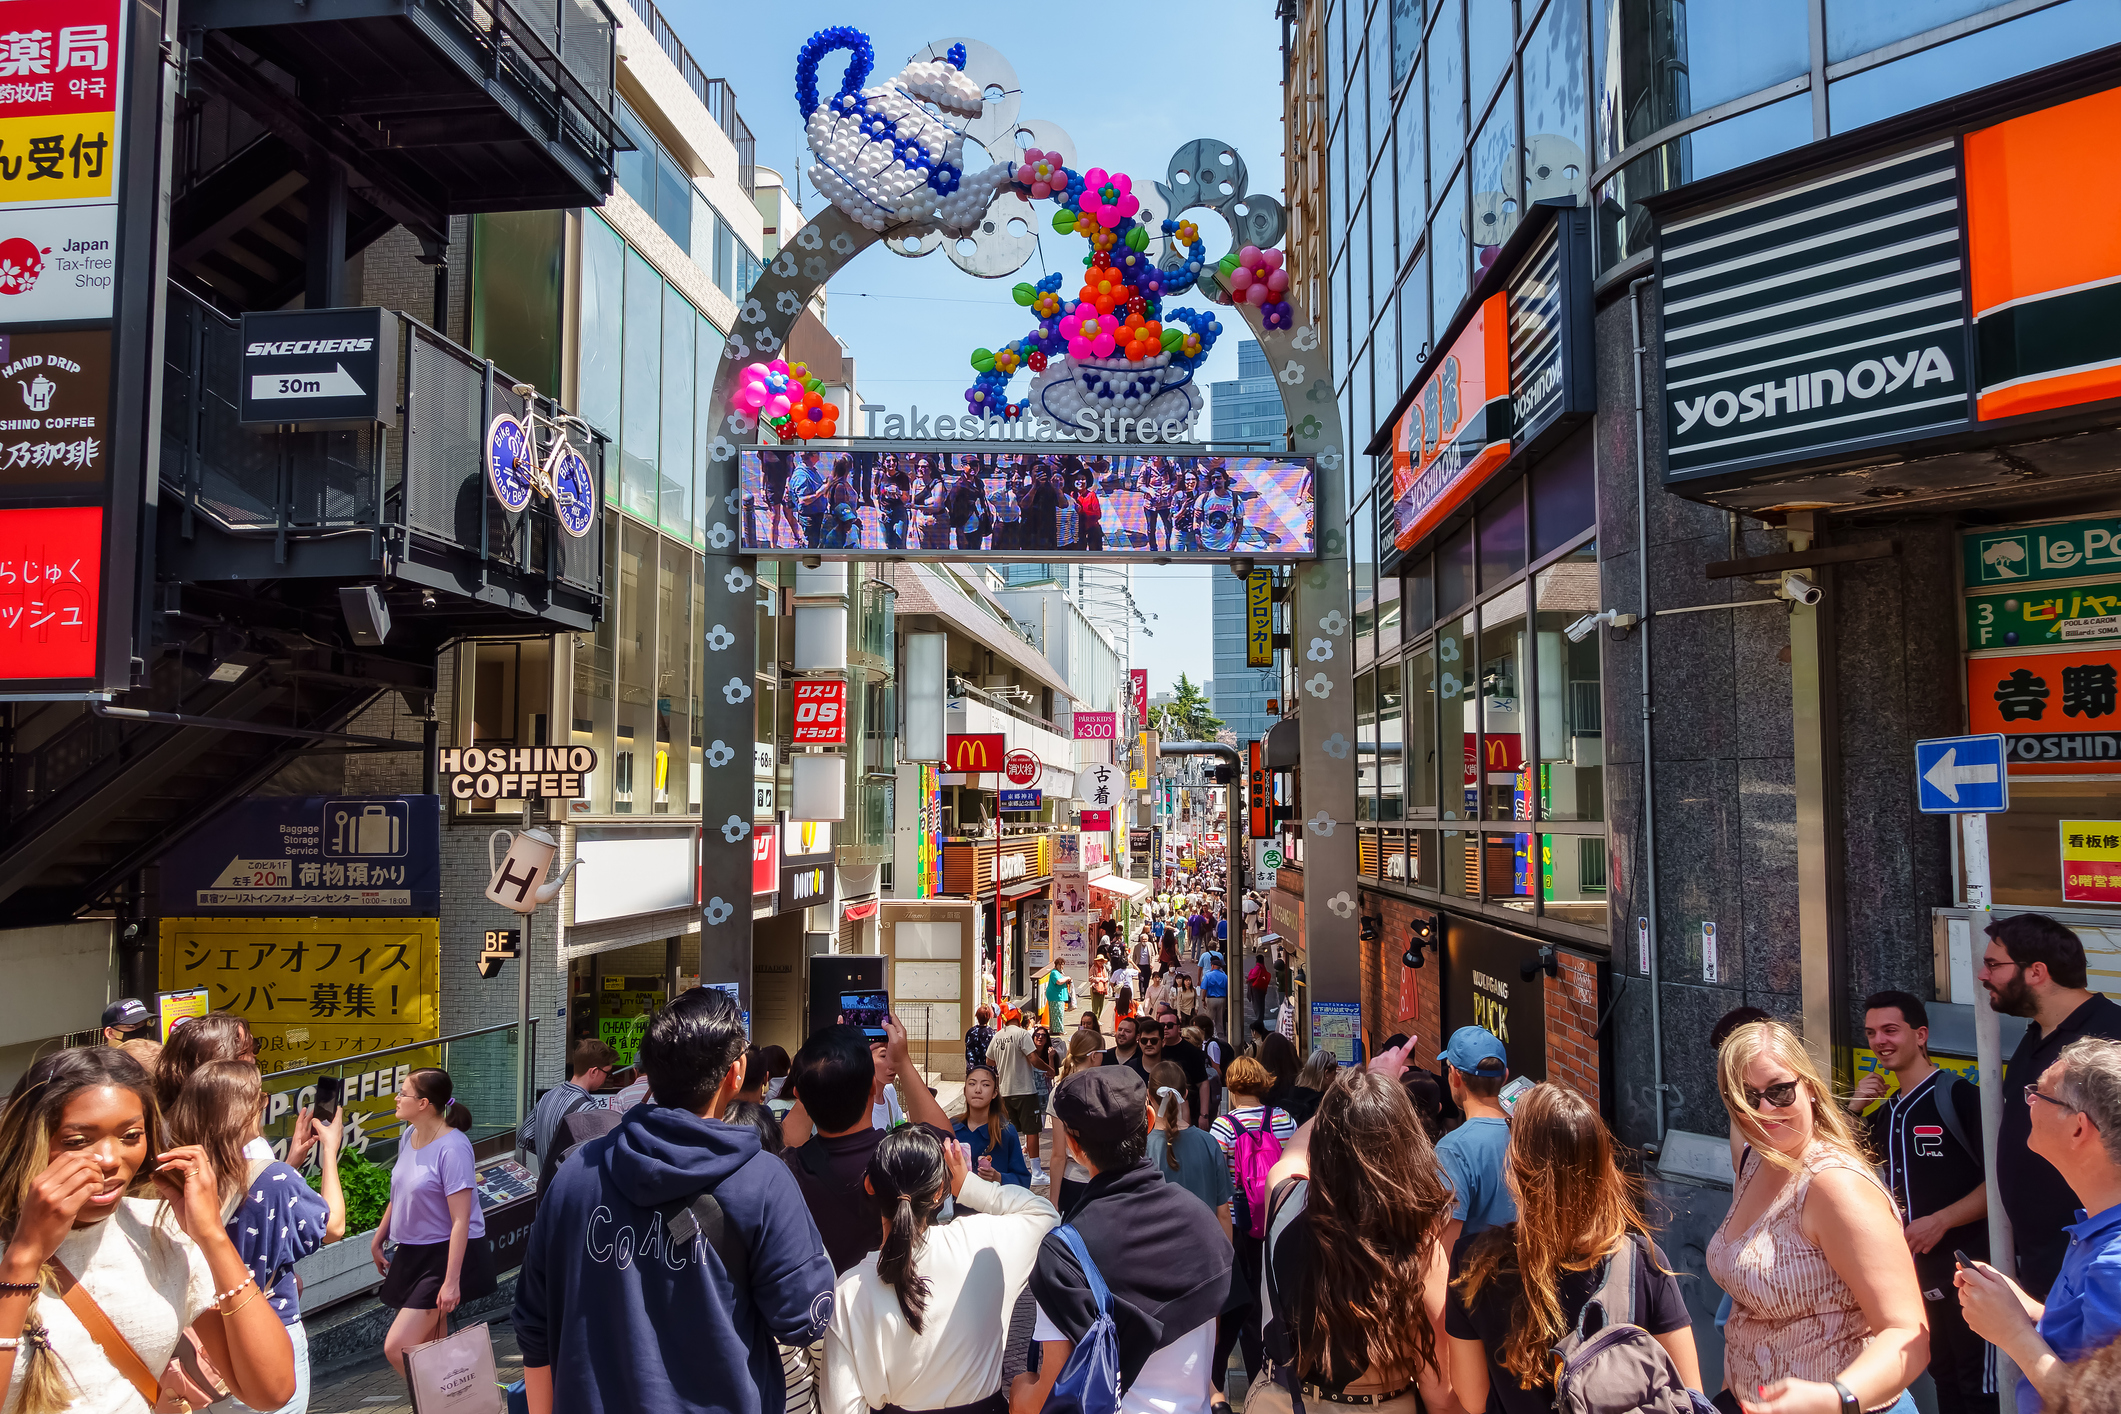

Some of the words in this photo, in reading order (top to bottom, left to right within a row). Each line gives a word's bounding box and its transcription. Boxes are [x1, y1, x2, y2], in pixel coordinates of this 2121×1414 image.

[0, 25, 108, 77] 薬局
[69, 78, 107, 99] 약국
[63, 238, 109, 253] Japan
[55, 257, 112, 272] Tax-free
[75, 273, 111, 290] Shop
[245, 337, 374, 356] SKECHERS
[1, 355, 43, 378] HAND
[47, 355, 81, 373] DRIP
[278, 379, 320, 394] 30m
[1512, 354, 1562, 425] YOSHINOYA
[1674, 345, 1954, 435] YOSHINOYA
[45, 416, 95, 429] COFFEE
[860, 405, 1057, 442] Takeshita
[1075, 407, 1201, 444] Street
[494, 426, 511, 448] Bike
[0, 436, 101, 470] 乃珈琲
[1411, 441, 1462, 516] YOSHINOYA
[2039, 535, 2083, 569] Le
[1251, 571, 1270, 654] コインロッカー
[2024, 596, 2121, 621] ビリヤ
[798, 685, 838, 698] クスリ
[1994, 663, 2118, 722] 吉野
[796, 703, 839, 722] OS
[795, 727, 840, 738] ドラッグ
[1077, 724, 1112, 738] ¥300
[2007, 736, 2121, 758] YOSHIN
[439, 748, 592, 773] HOSHINO
[1008, 763, 1034, 776] 消火栓
[452, 774, 580, 799] COFFEE
[1093, 765, 1112, 804] 古着
[279, 824, 319, 835] Baggage
[283, 835, 319, 846] Storage
[285, 846, 319, 856] Service
[2069, 834, 2121, 848] 看板修
[253, 871, 288, 887] 20m
[299, 862, 405, 887] 荷物預かり
[493, 857, 538, 903] H
[793, 868, 825, 900] DOUTOR
[200, 893, 359, 904] 原宿ツーリストインフォメーションセンター
[485, 931, 509, 951] BF
[184, 940, 411, 974] シェアオフィス
[1472, 969, 1509, 999] WOLFGANG
[197, 981, 399, 1018] ンバー募集！
[603, 1021, 630, 1034] CHEAP
[1473, 992, 1509, 1043] PUCK
[296, 1064, 411, 1117] CFFEE
